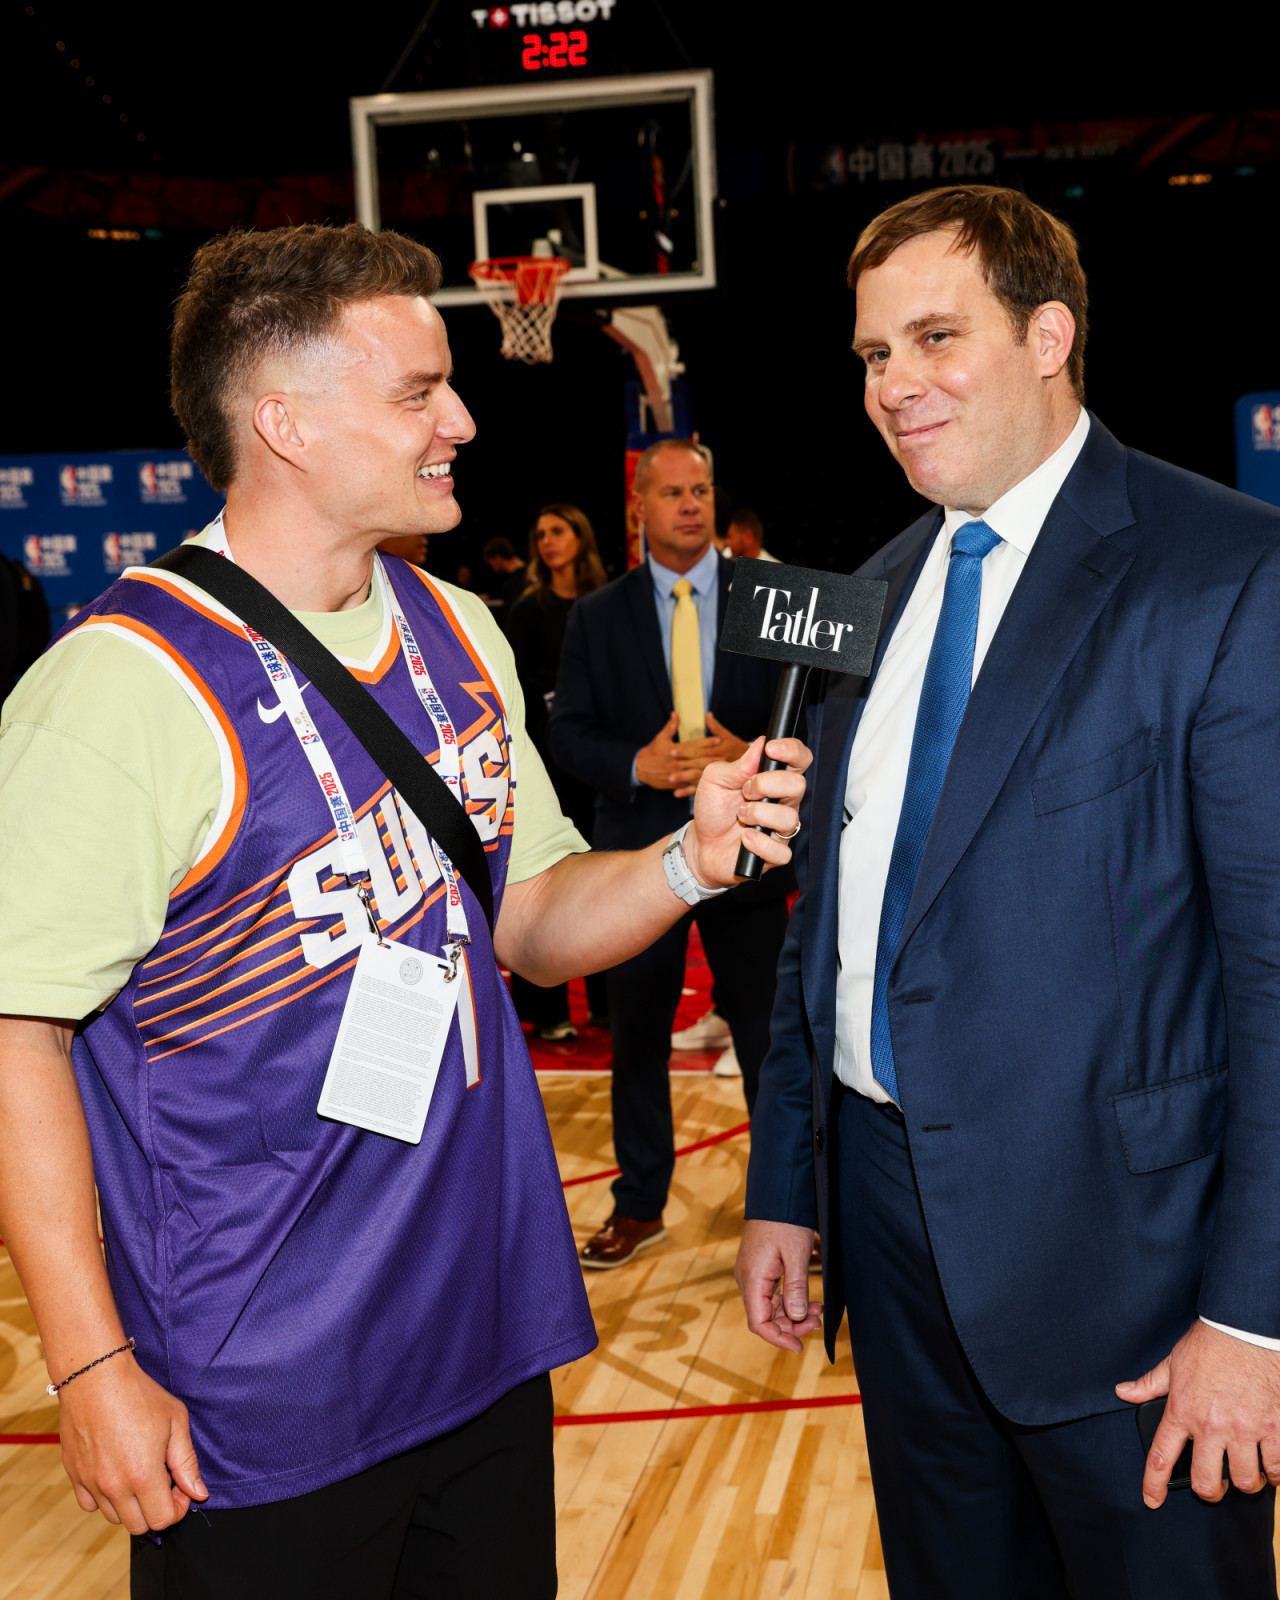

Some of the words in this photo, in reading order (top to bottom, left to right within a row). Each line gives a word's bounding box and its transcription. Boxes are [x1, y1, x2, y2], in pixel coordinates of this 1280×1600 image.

[510, 0, 616, 28] TISSOT
[522, 30, 588, 70] 2:22
[753, 585, 853, 653] Tatler
